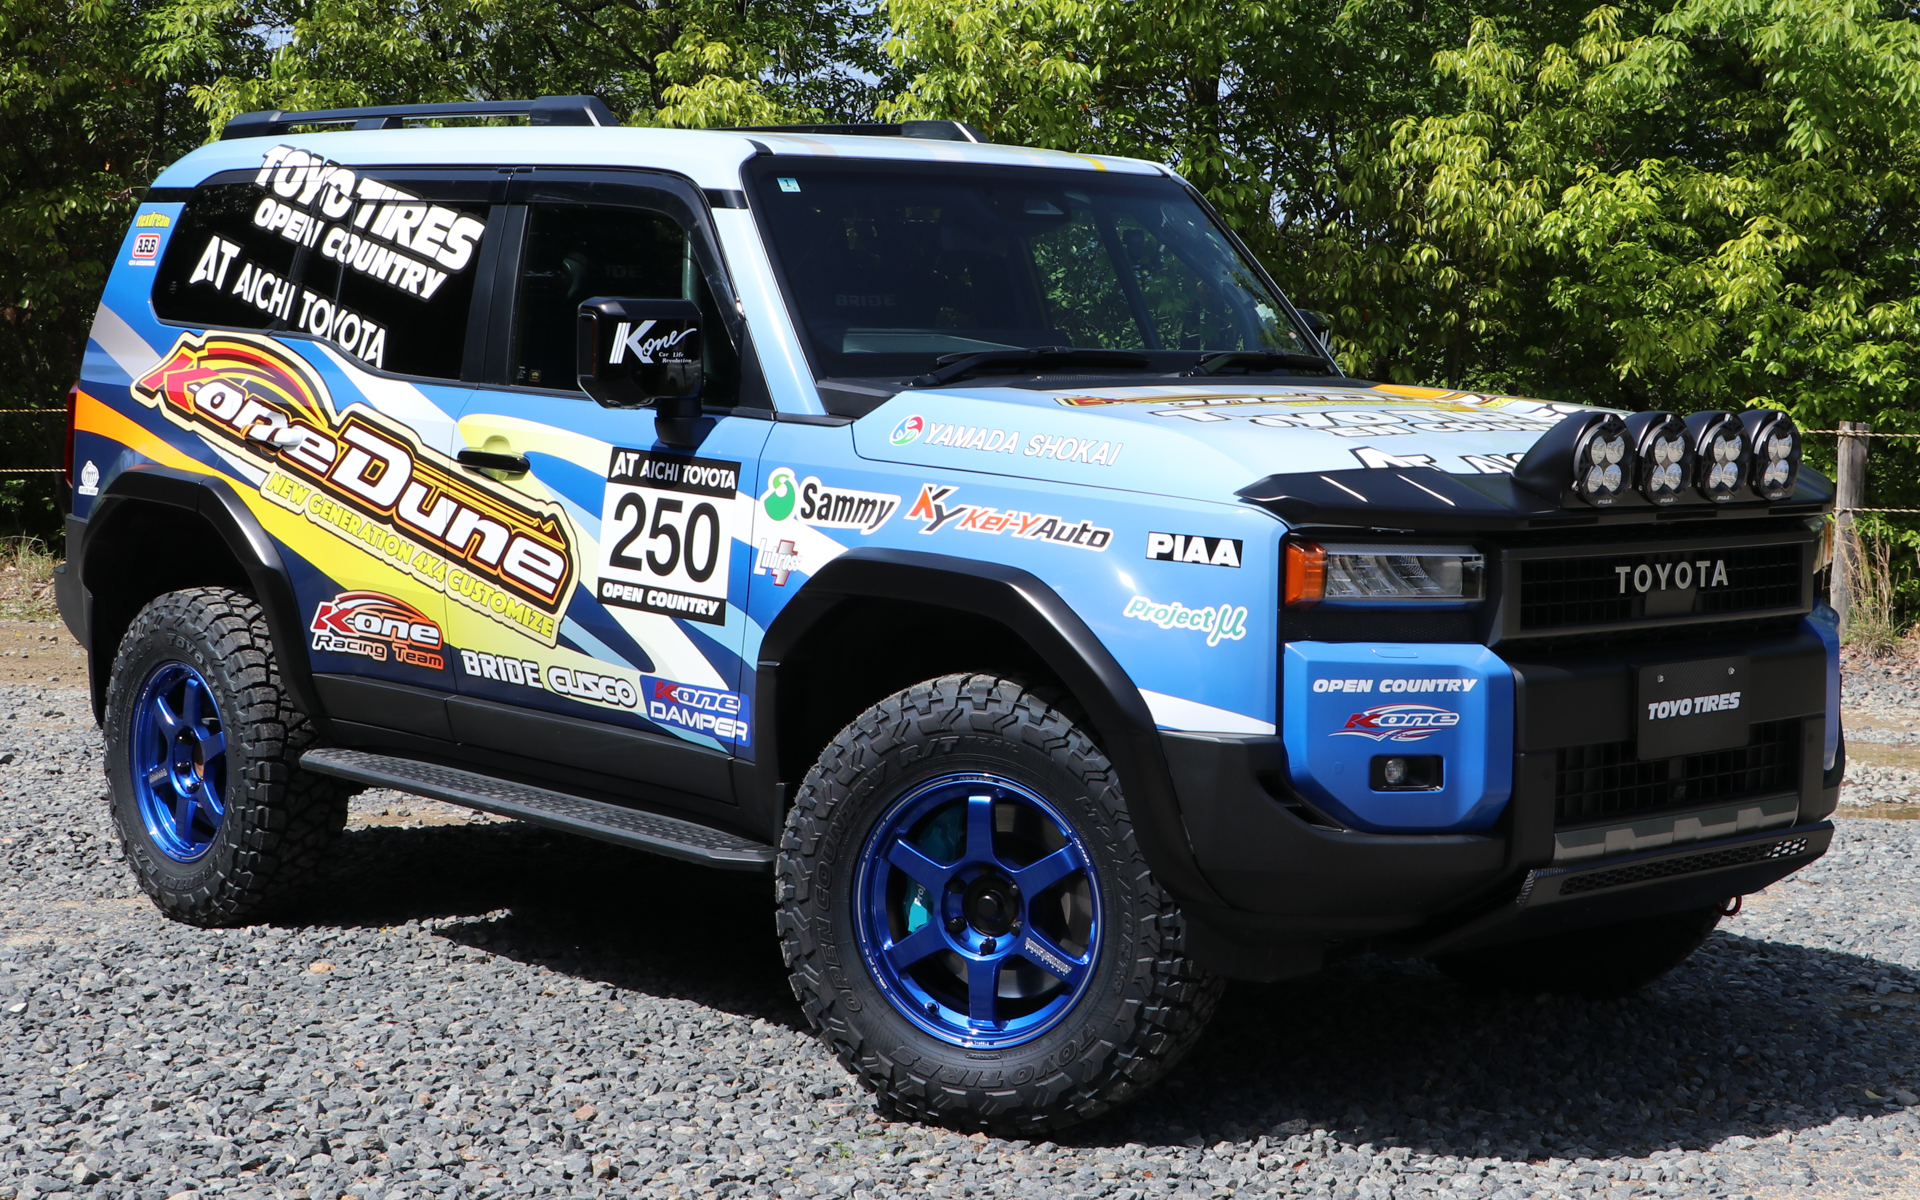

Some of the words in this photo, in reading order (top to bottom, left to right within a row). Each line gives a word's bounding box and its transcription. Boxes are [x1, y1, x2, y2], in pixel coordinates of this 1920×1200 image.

[254, 144, 356, 219] TOYO
[354, 178, 485, 271] TIRES
[136, 239, 157, 253] ARB
[255, 198, 325, 249] OPEN
[322, 227, 448, 300] COUNTRY
[190, 236, 241, 290] AT
[232, 262, 297, 321] AICHI
[298, 289, 386, 369] TOYOTA
[924, 422, 1020, 454] YAMADA
[1023, 434, 1124, 467] SHOKAI
[611, 452, 639, 478] AT
[640, 459, 679, 481] AICHI
[682, 465, 736, 490] TOYOTA
[800, 483, 894, 532] Sammy
[266, 472, 311, 506] NEW
[308, 493, 415, 565] GENERATION
[412, 551, 448, 583] 4X4
[448, 569, 555, 639] CUSTOMIZE
[609, 492, 720, 583] 250
[1146, 532, 1241, 567] PIAA
[1615, 560, 1729, 594] TOYOTA
[602, 582, 644, 603] OPEN
[646, 591, 720, 617] COUNTRY
[1127, 599, 1213, 629] Project
[314, 634, 386, 658] Racing
[394, 645, 443, 668] Team
[461, 650, 544, 688] BRIDE
[548, 667, 636, 707] CUSCO
[1313, 679, 1374, 693] OPEN
[1379, 678, 1478, 693] COUNTRY
[650, 700, 748, 742] DAMPER
[1648, 698, 1692, 720] TOYO
[1694, 691, 1741, 714] TIRES
[816, 761, 889, 911] COUNTRY
[815, 917, 863, 1014] OPEN
[889, 1045, 1005, 1089] TIRES
[1009, 1025, 1099, 1086] TOYO
